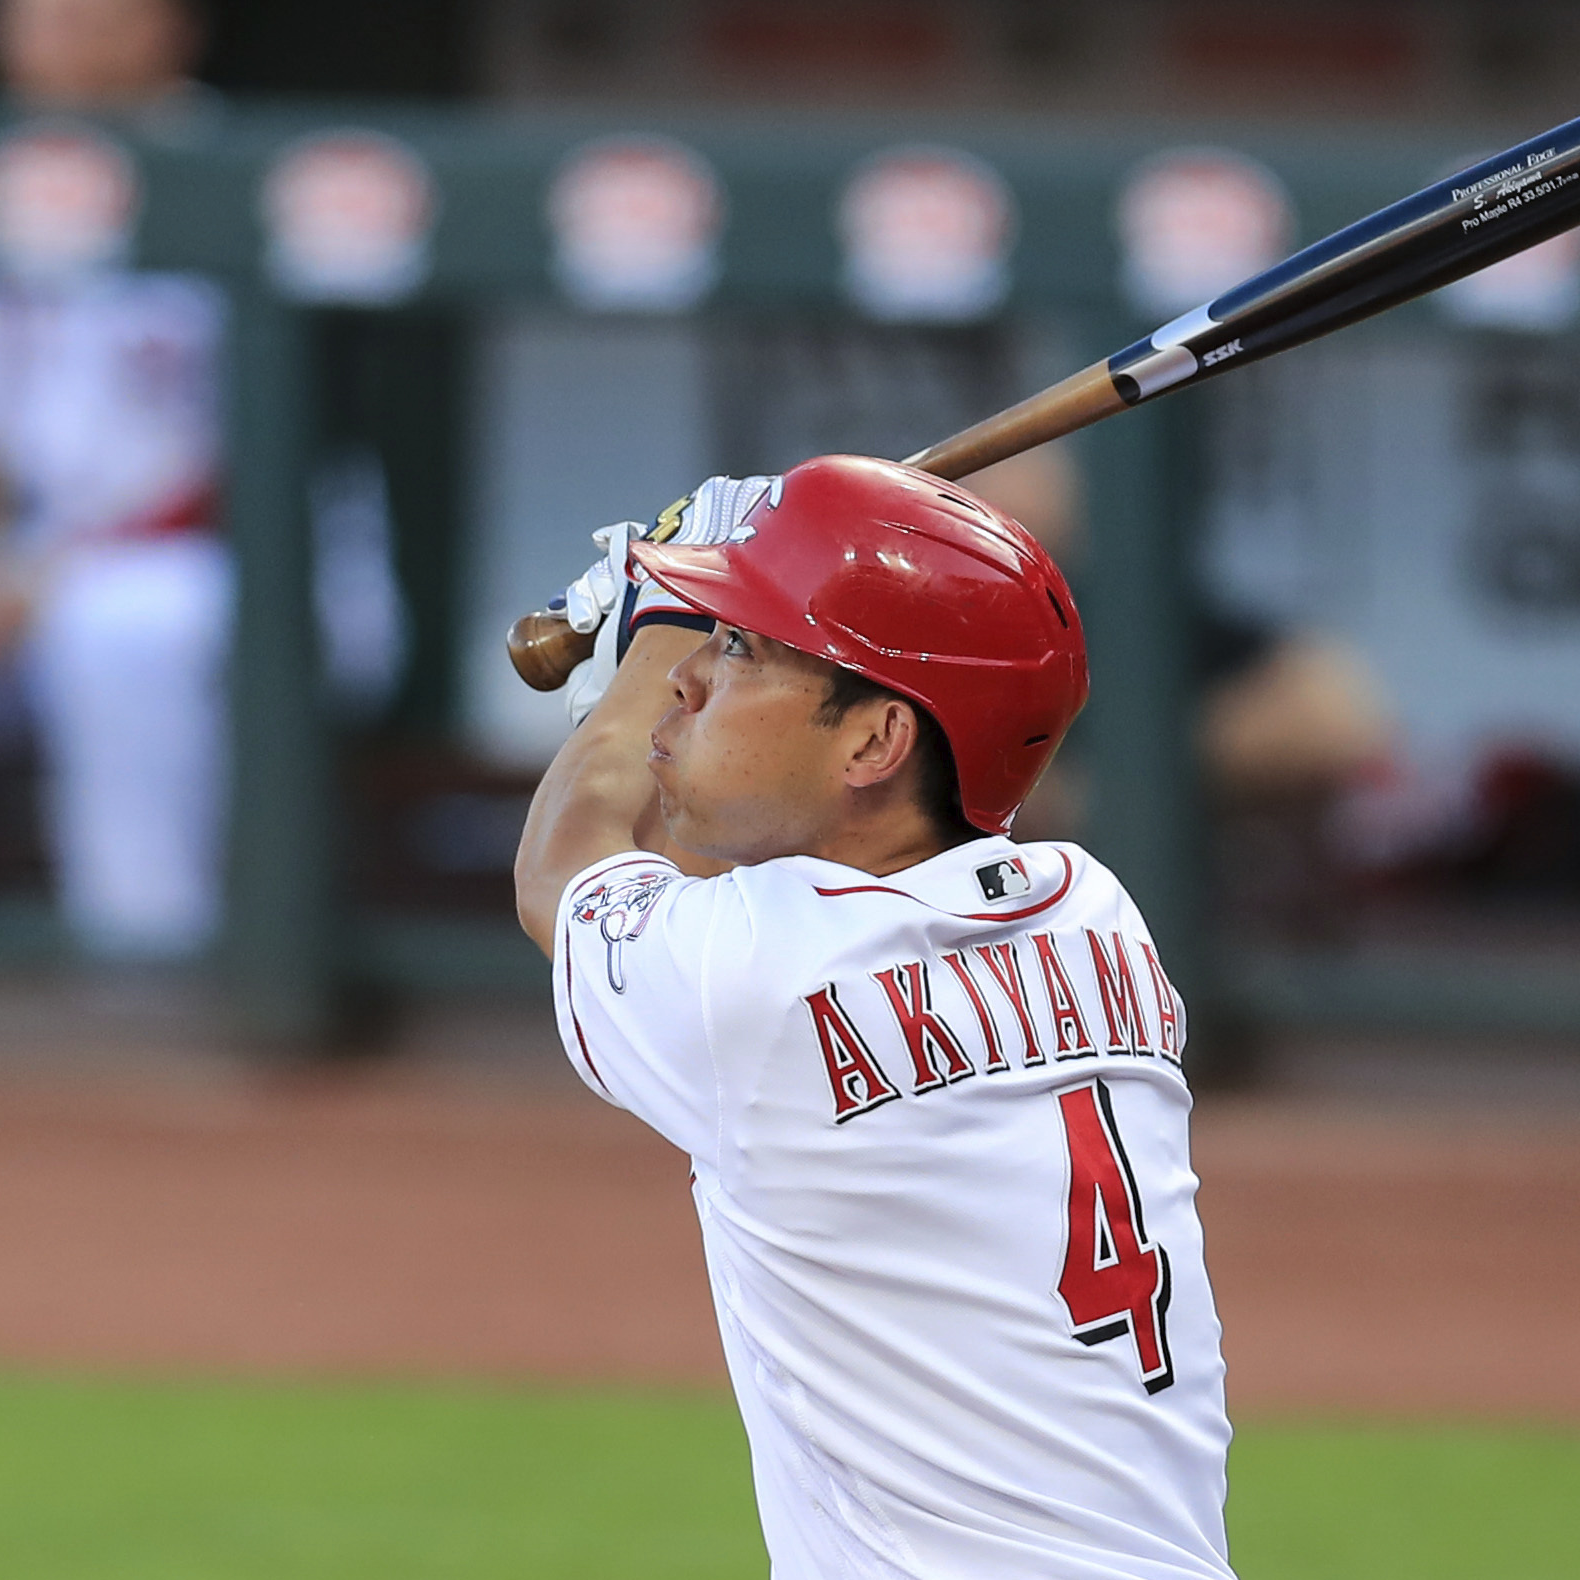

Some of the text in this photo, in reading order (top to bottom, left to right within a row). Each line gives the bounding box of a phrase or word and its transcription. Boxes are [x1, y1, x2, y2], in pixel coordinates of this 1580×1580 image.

[1527, 147, 1556, 167] EDGE
[1461, 219, 1480, 231] Pro
[1480, 205, 1508, 222] Maple
[1203, 338, 1244, 367] SSK
[800, 927, 1182, 1125] AKIYAMA
[1051, 1077, 1175, 1396] 4
